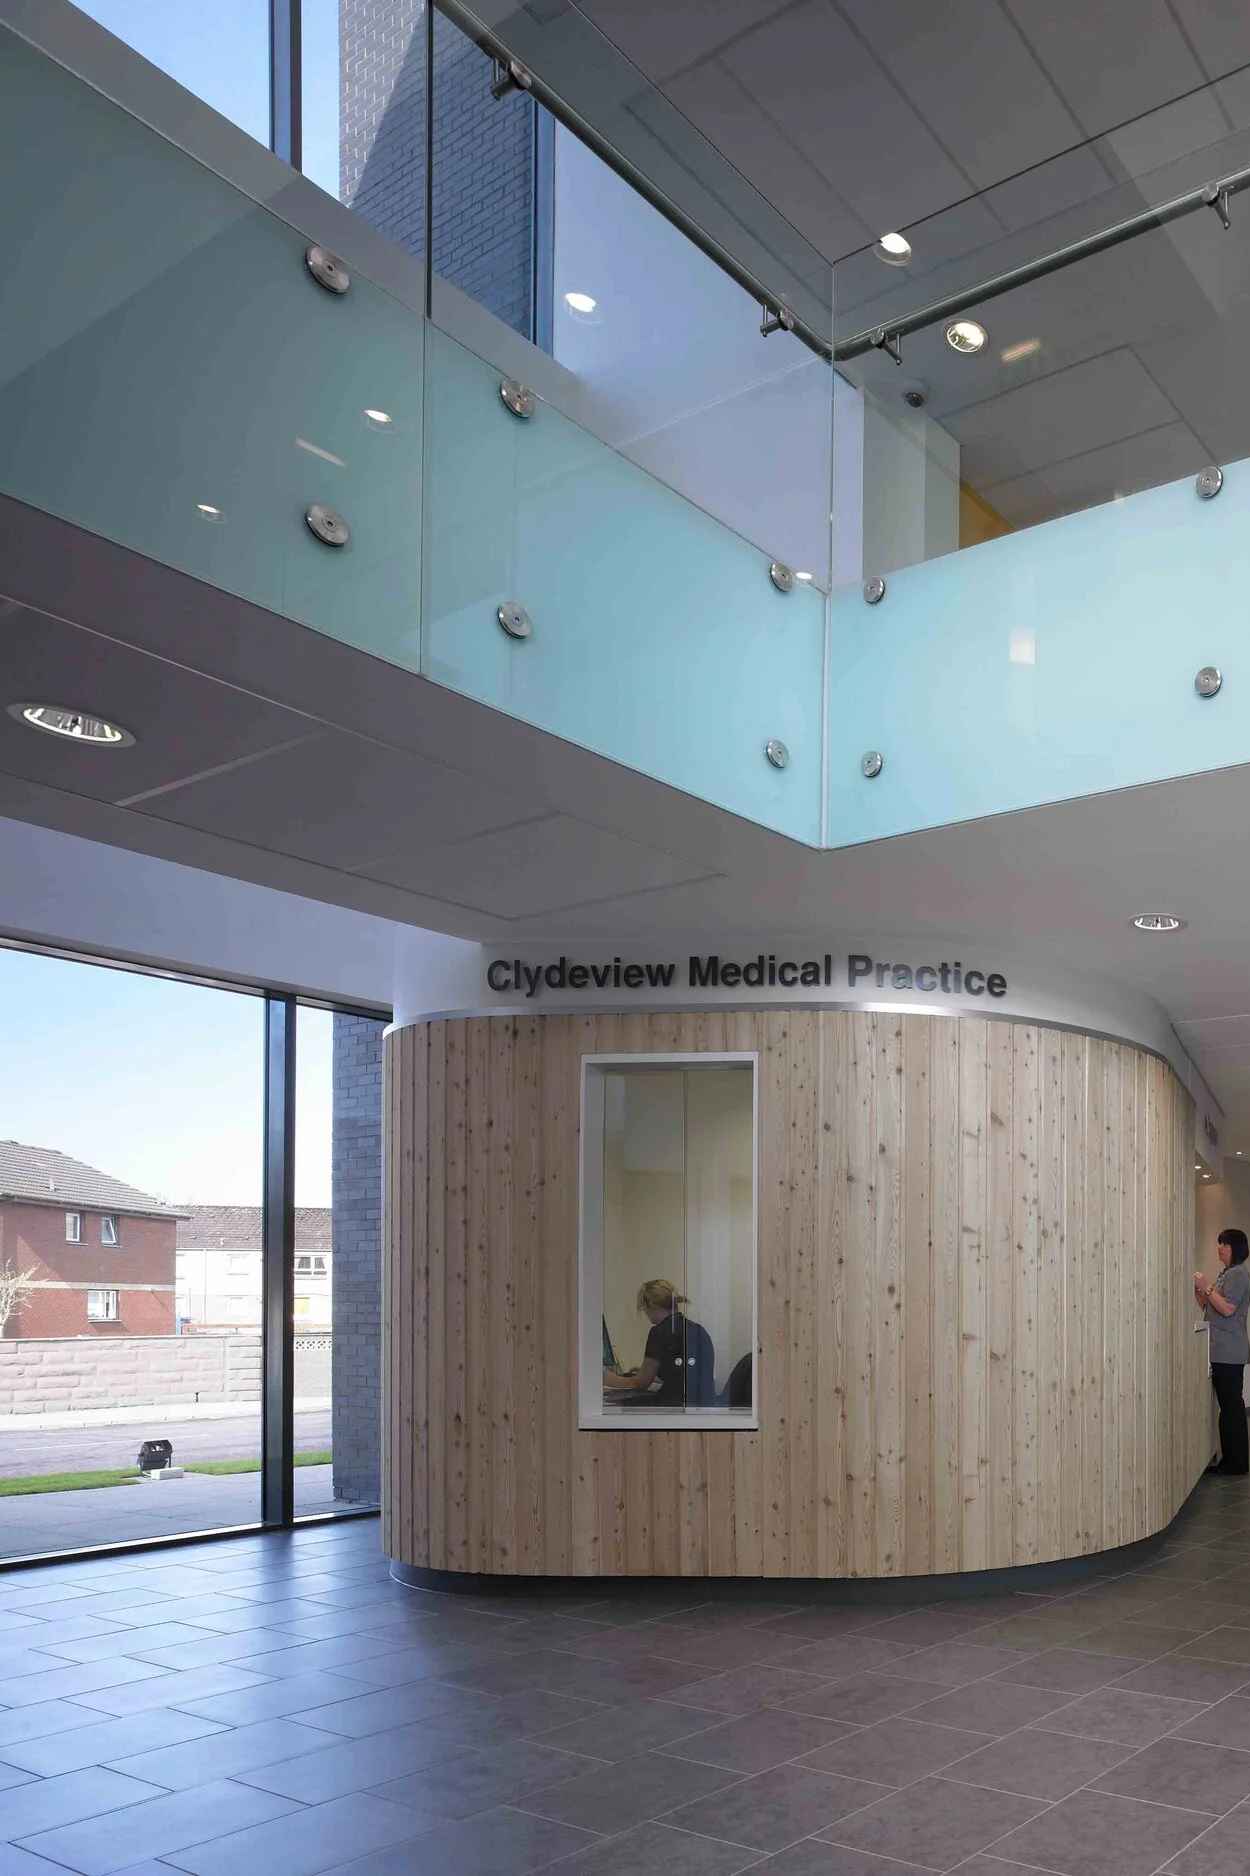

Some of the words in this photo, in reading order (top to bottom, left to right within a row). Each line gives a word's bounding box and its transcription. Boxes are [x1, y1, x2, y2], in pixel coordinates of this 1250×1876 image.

[487, 956, 676, 998] Clydeview
[688, 954, 832, 987] Medical
[848, 954, 1007, 998] Practice
